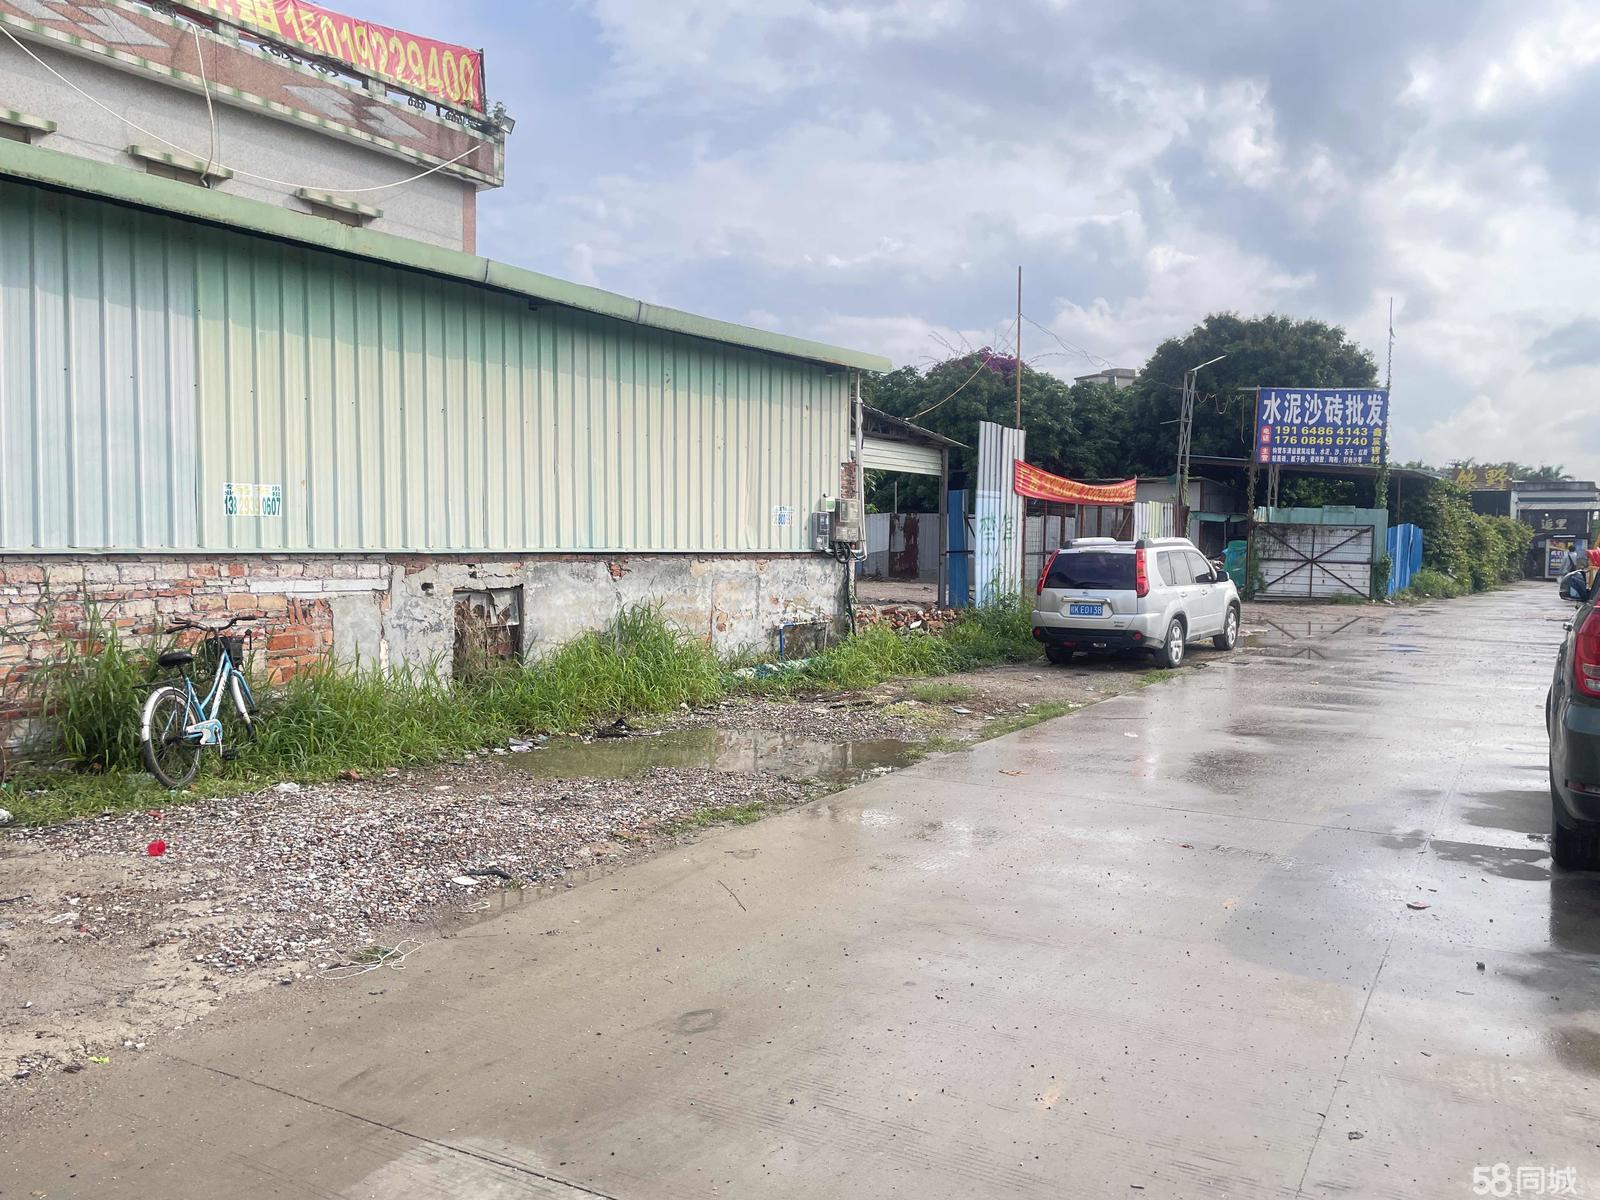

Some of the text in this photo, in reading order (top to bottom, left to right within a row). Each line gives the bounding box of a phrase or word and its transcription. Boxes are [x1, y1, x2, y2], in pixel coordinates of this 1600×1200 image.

[284, 5, 475, 103] 15019229400
[1262, 391, 1385, 426] 水泥沙砖批发
[1274, 436, 1368, 446] 176 0849 6740
[1275, 426, 1368, 436] 191 6486 4143
